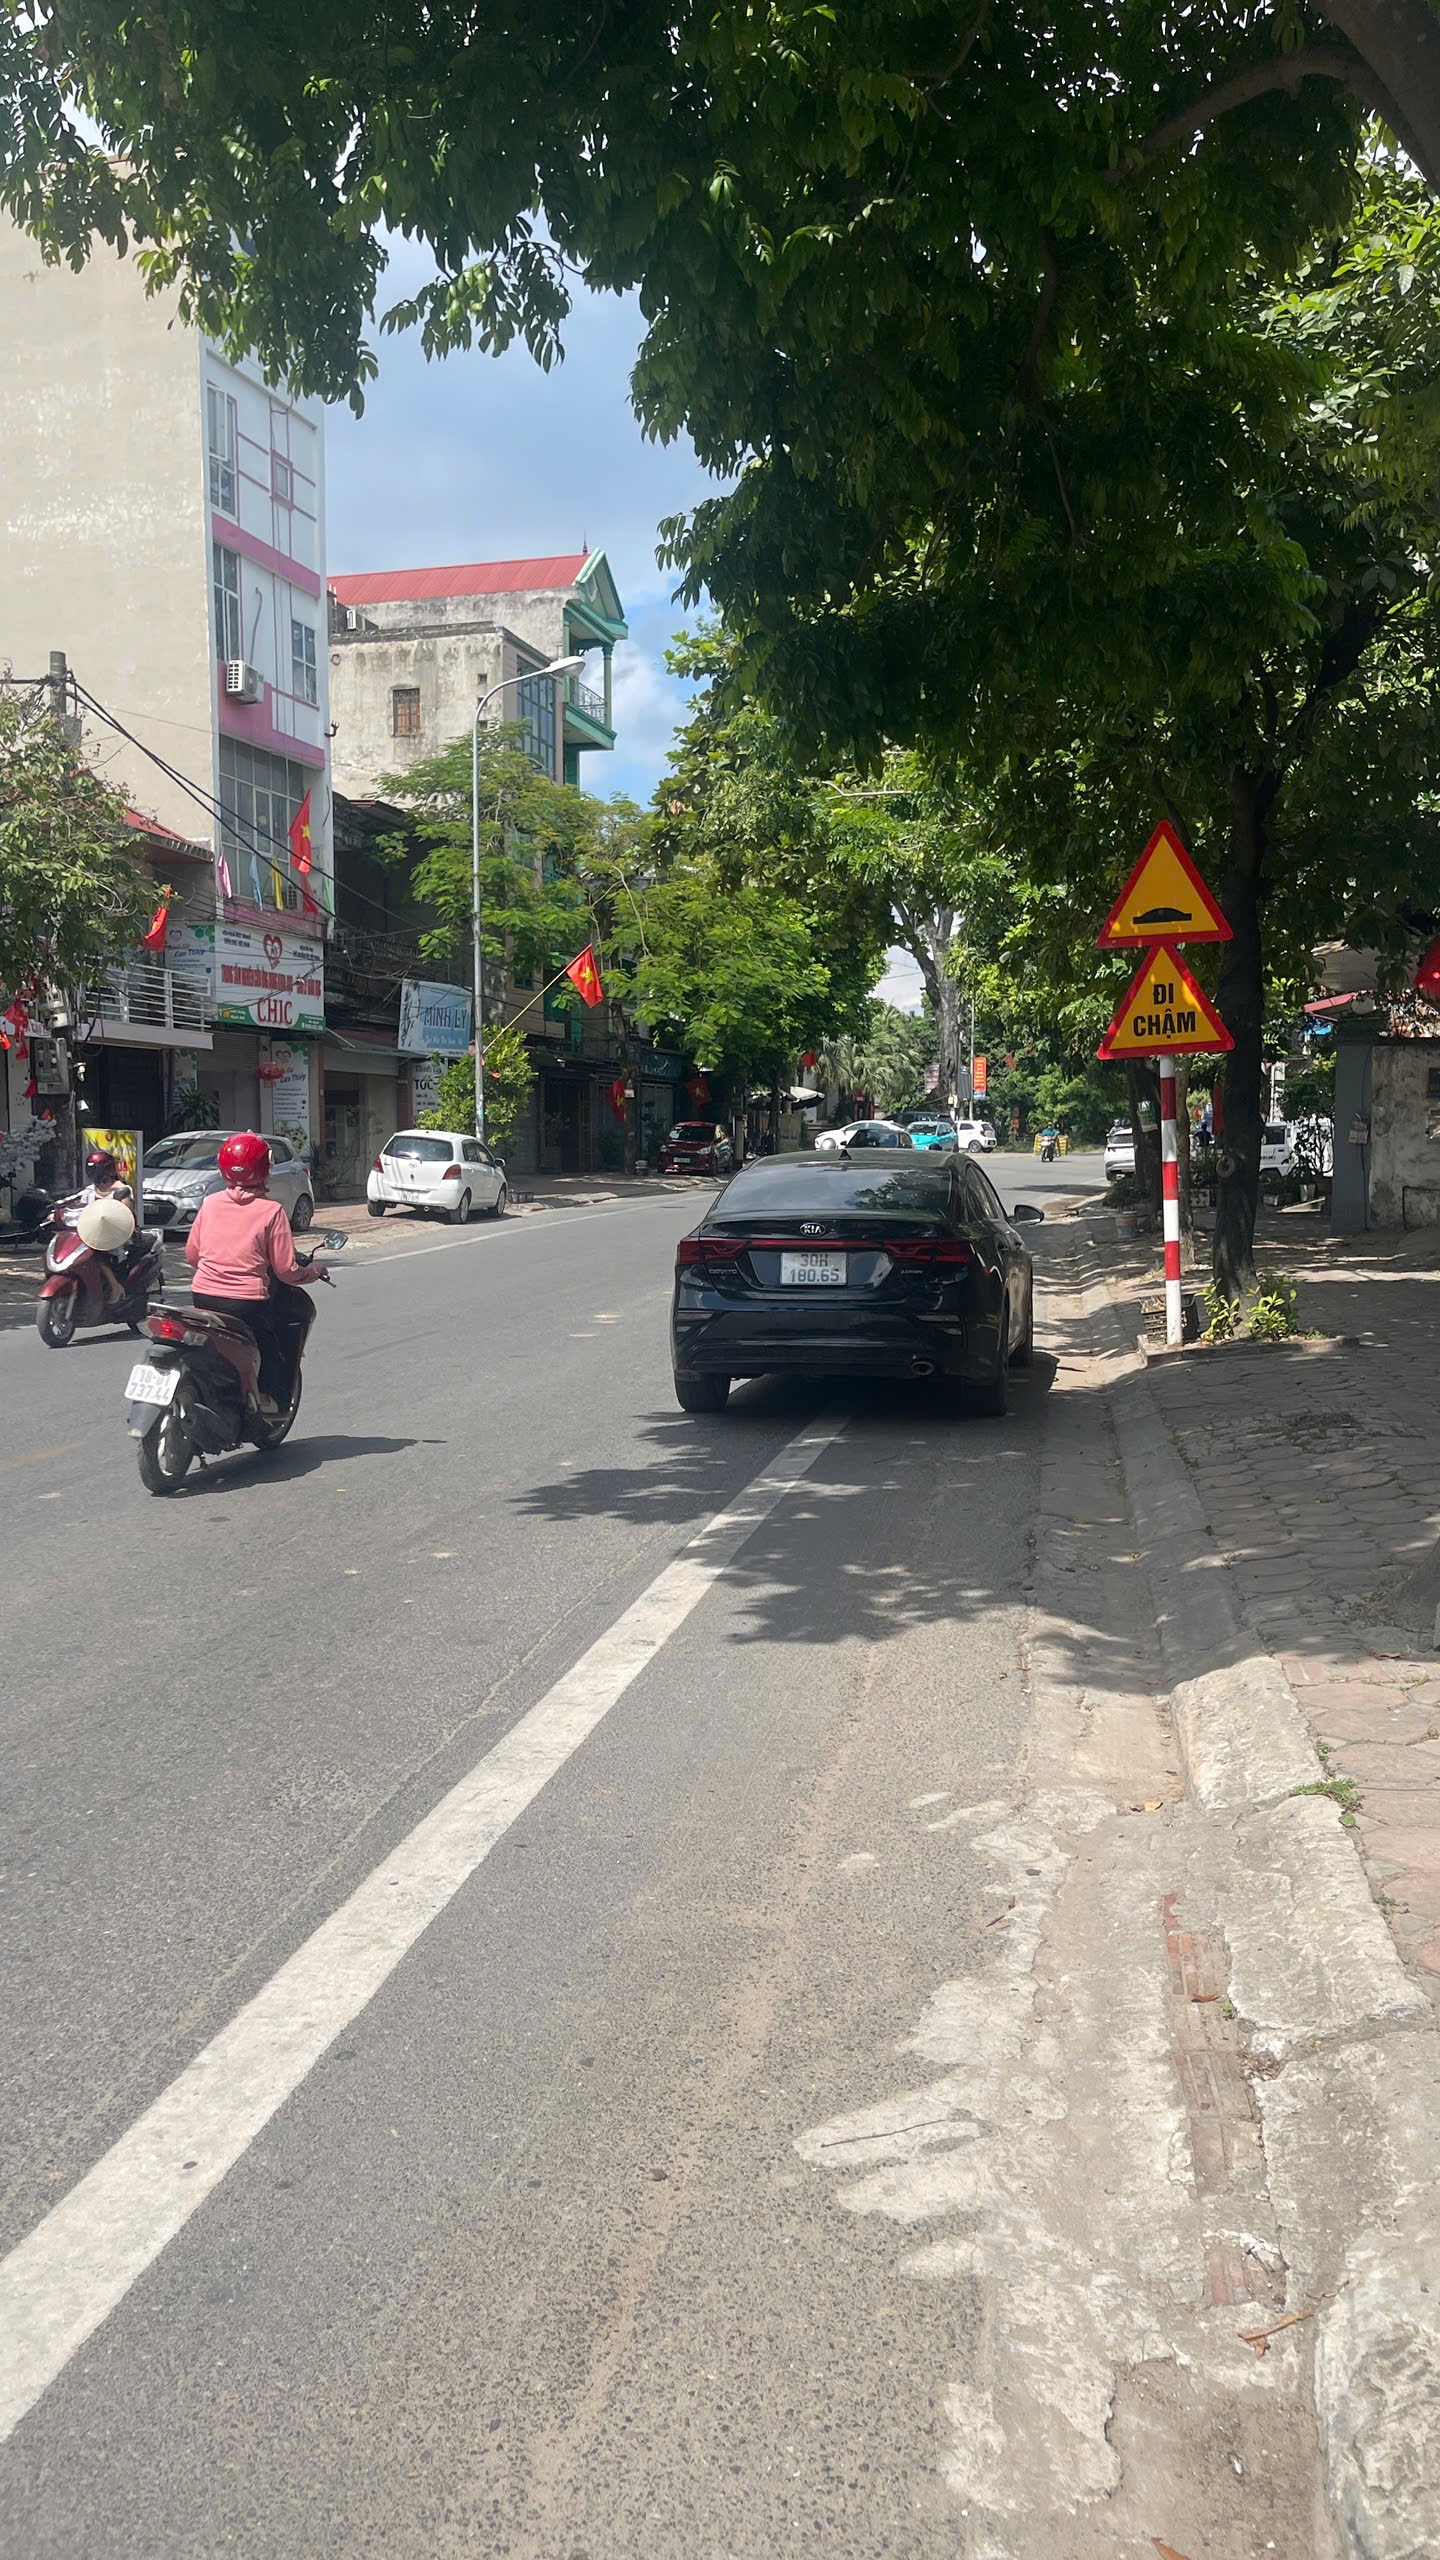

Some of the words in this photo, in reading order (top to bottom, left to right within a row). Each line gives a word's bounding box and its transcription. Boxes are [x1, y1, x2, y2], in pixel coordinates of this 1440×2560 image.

[1153, 983, 1174, 1005] ĐI
[257, 998, 293, 1025] CHIC
[424, 1006, 452, 1027] MINH
[1133, 1008, 1196, 1039] CHẬM
[804, 1225, 822, 1234] KIA
[800, 1253, 828, 1267] 30H
[790, 1269, 839, 1283] 180.65
